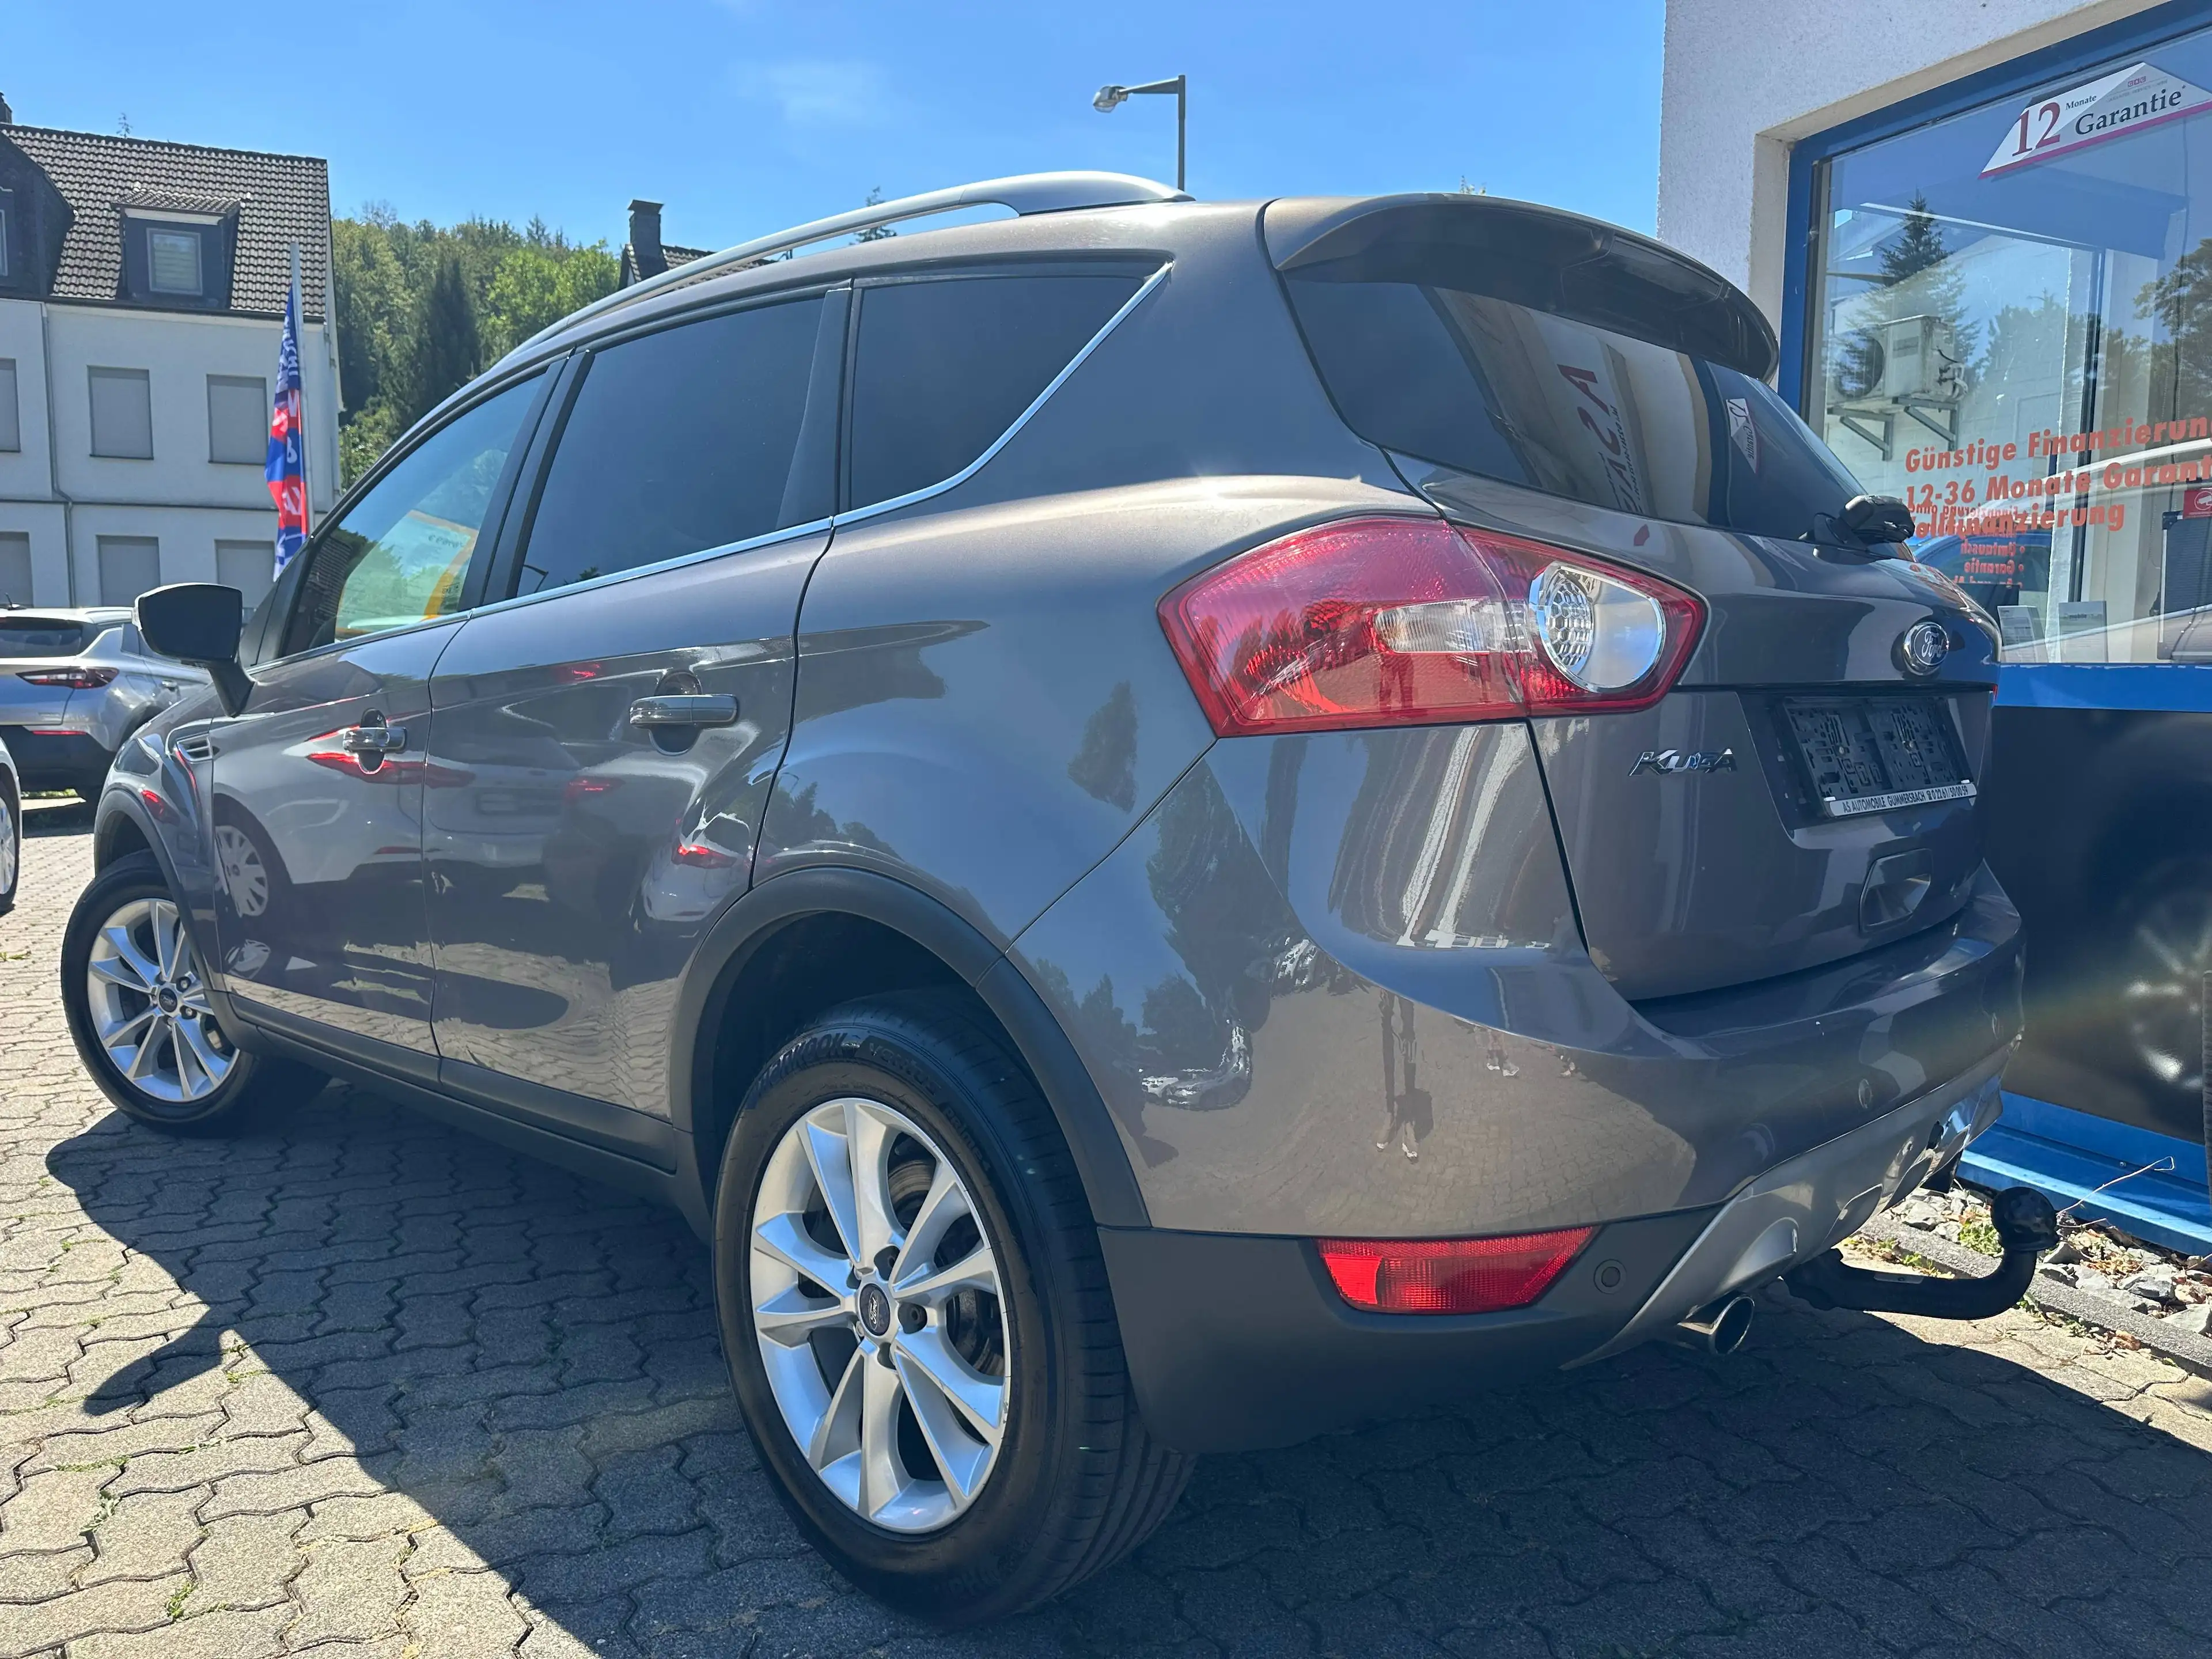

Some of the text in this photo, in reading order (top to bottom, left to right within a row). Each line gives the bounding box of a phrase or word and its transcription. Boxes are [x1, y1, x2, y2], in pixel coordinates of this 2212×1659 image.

[2012, 101, 2061, 157] 12
[2065, 94, 2097, 111] Monate
[1906, 417, 2212, 473] Günstige Finanzierun
[1906, 482, 1975, 510] 12-36
[1986, 471, 2091, 501] Monate
[1914, 503, 2125, 539] ollfinanzierung
[1921, 631, 1946, 658] Ford
[1843, 801, 1852, 813] AS
[1853, 796, 1886, 812] AUTOMOBILE
[1887, 791, 1926, 807] GUMMERSBACH
